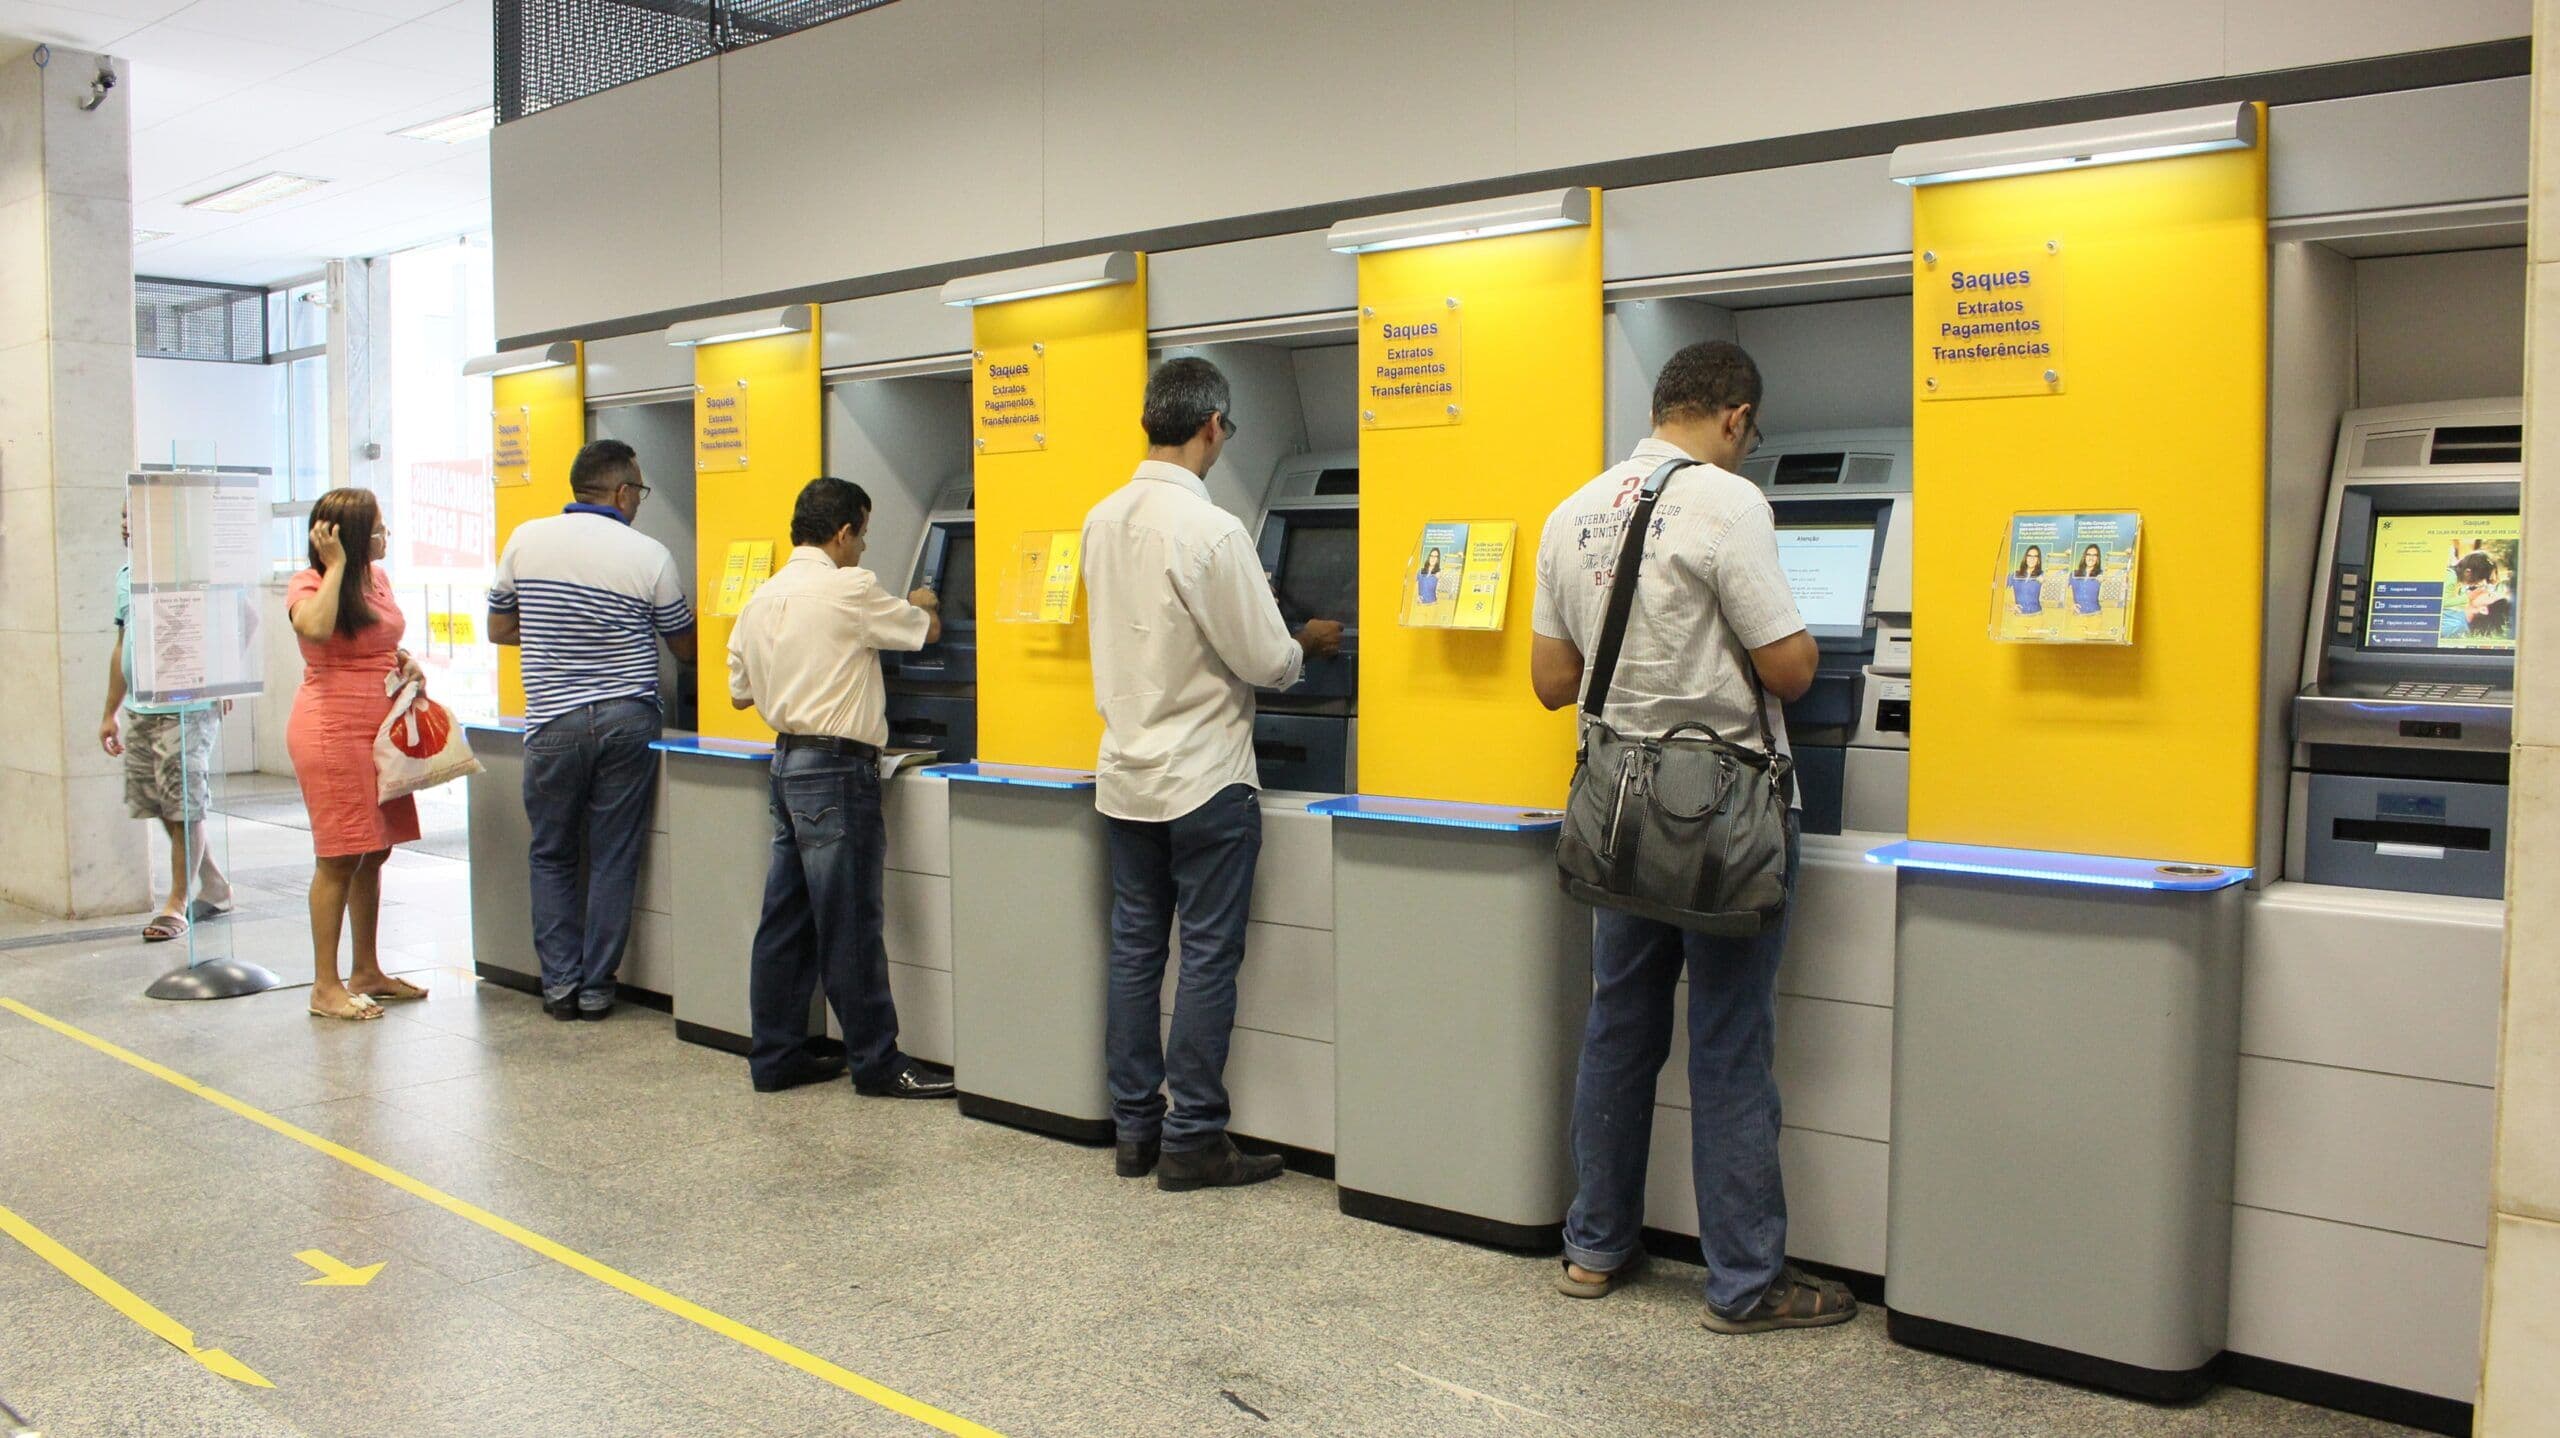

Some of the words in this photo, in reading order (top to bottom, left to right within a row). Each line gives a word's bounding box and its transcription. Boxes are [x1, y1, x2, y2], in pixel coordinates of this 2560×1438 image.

[1952, 270, 2030, 291] Saques
[1958, 300, 2023, 315] Extratos
[1383, 323, 1438, 340] Saques
[1942, 319, 2040, 338] Pagamentos
[1388, 347, 1433, 359] Extratos
[1933, 341, 2050, 359] Transferências
[989, 364, 1028, 378] Saques
[1377, 363, 1445, 379] Pagamentos
[993, 384, 1025, 395] Extratos
[1371, 381, 1452, 396] Transferências
[706, 397, 734, 409] Saques
[985, 398, 1034, 411] Pagamentos
[709, 415, 732, 423] Extratos
[981, 414, 1039, 425] Transferências
[1656, 504, 1681, 516] CLUB
